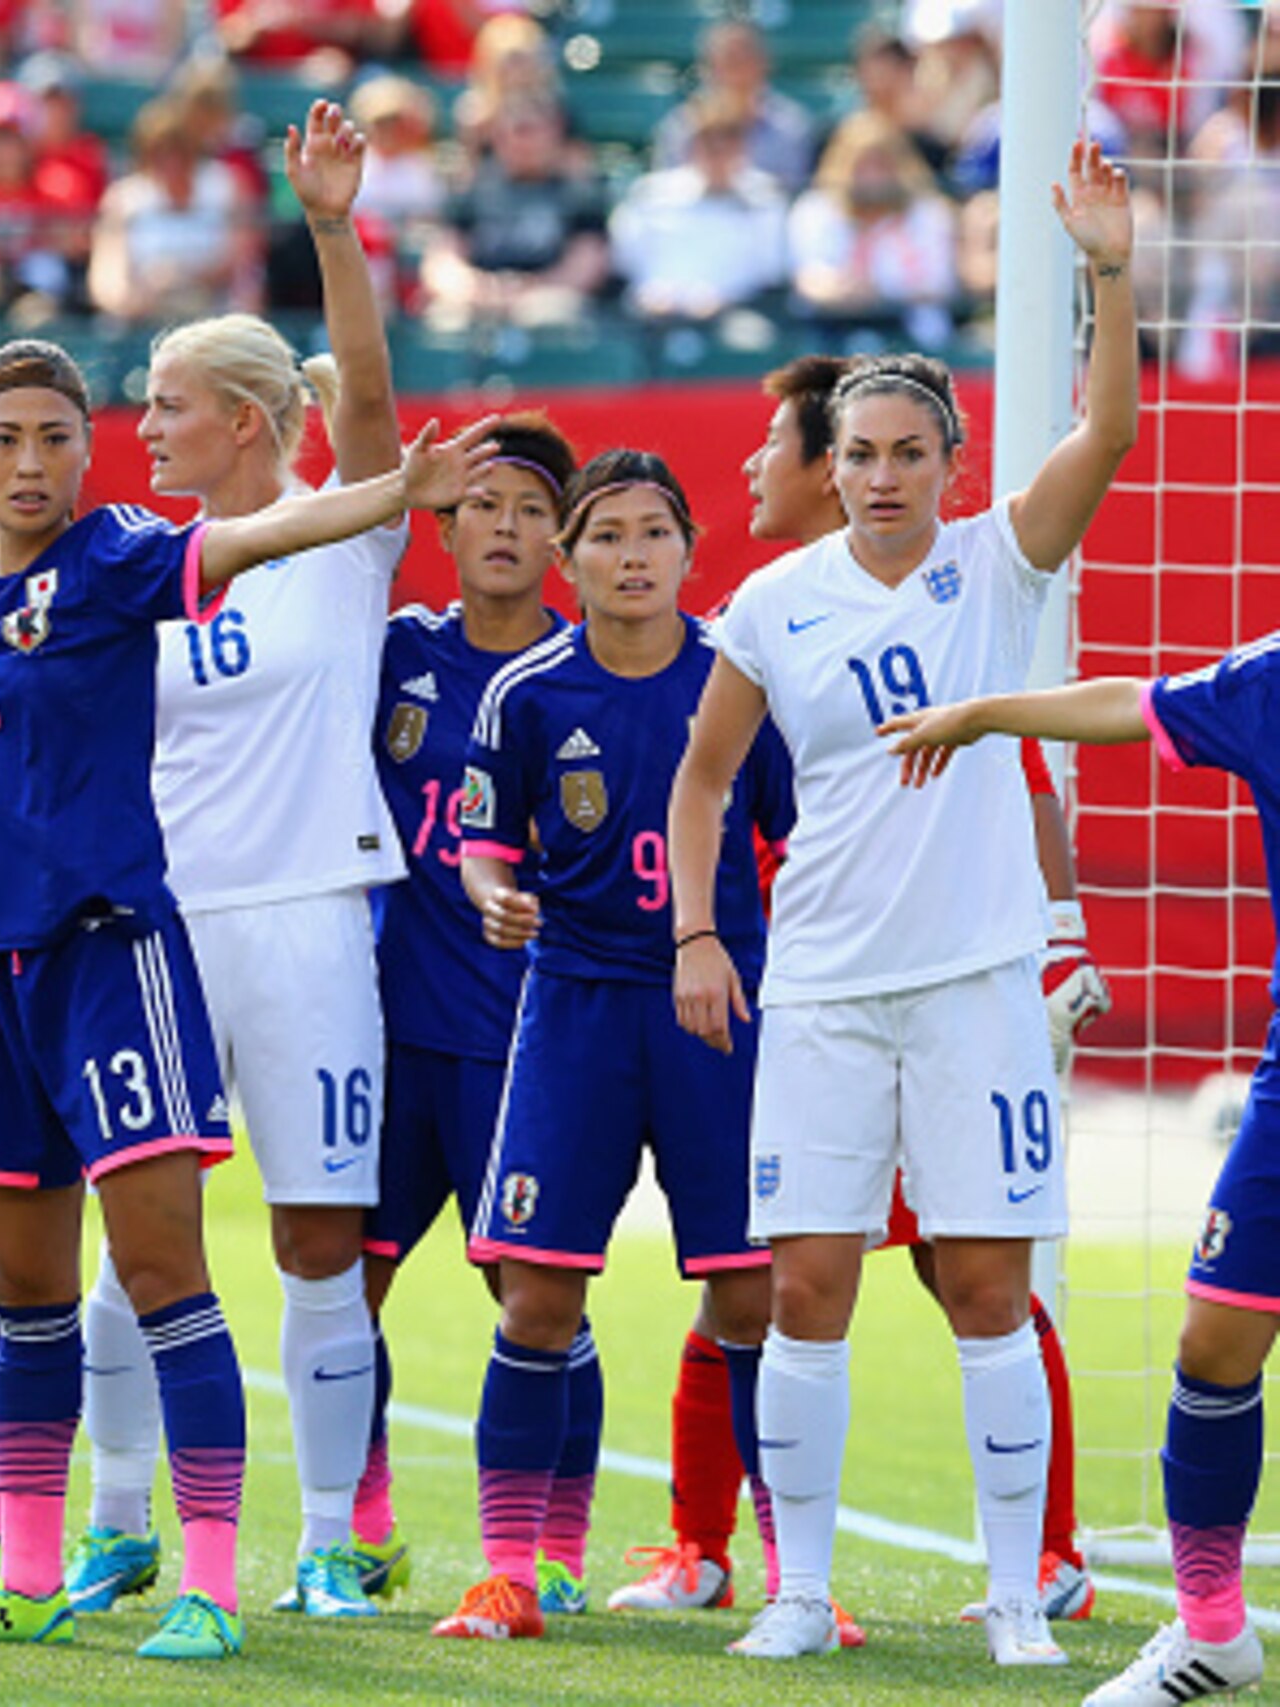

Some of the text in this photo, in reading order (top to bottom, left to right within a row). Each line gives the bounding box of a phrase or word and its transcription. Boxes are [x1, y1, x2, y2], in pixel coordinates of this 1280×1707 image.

[185, 608, 250, 686] 16
[847, 643, 931, 725] 19
[632, 830, 669, 911] 9
[82, 1049, 156, 1140] 13
[316, 1067, 372, 1147] 16
[990, 1090, 1052, 1174] 19
